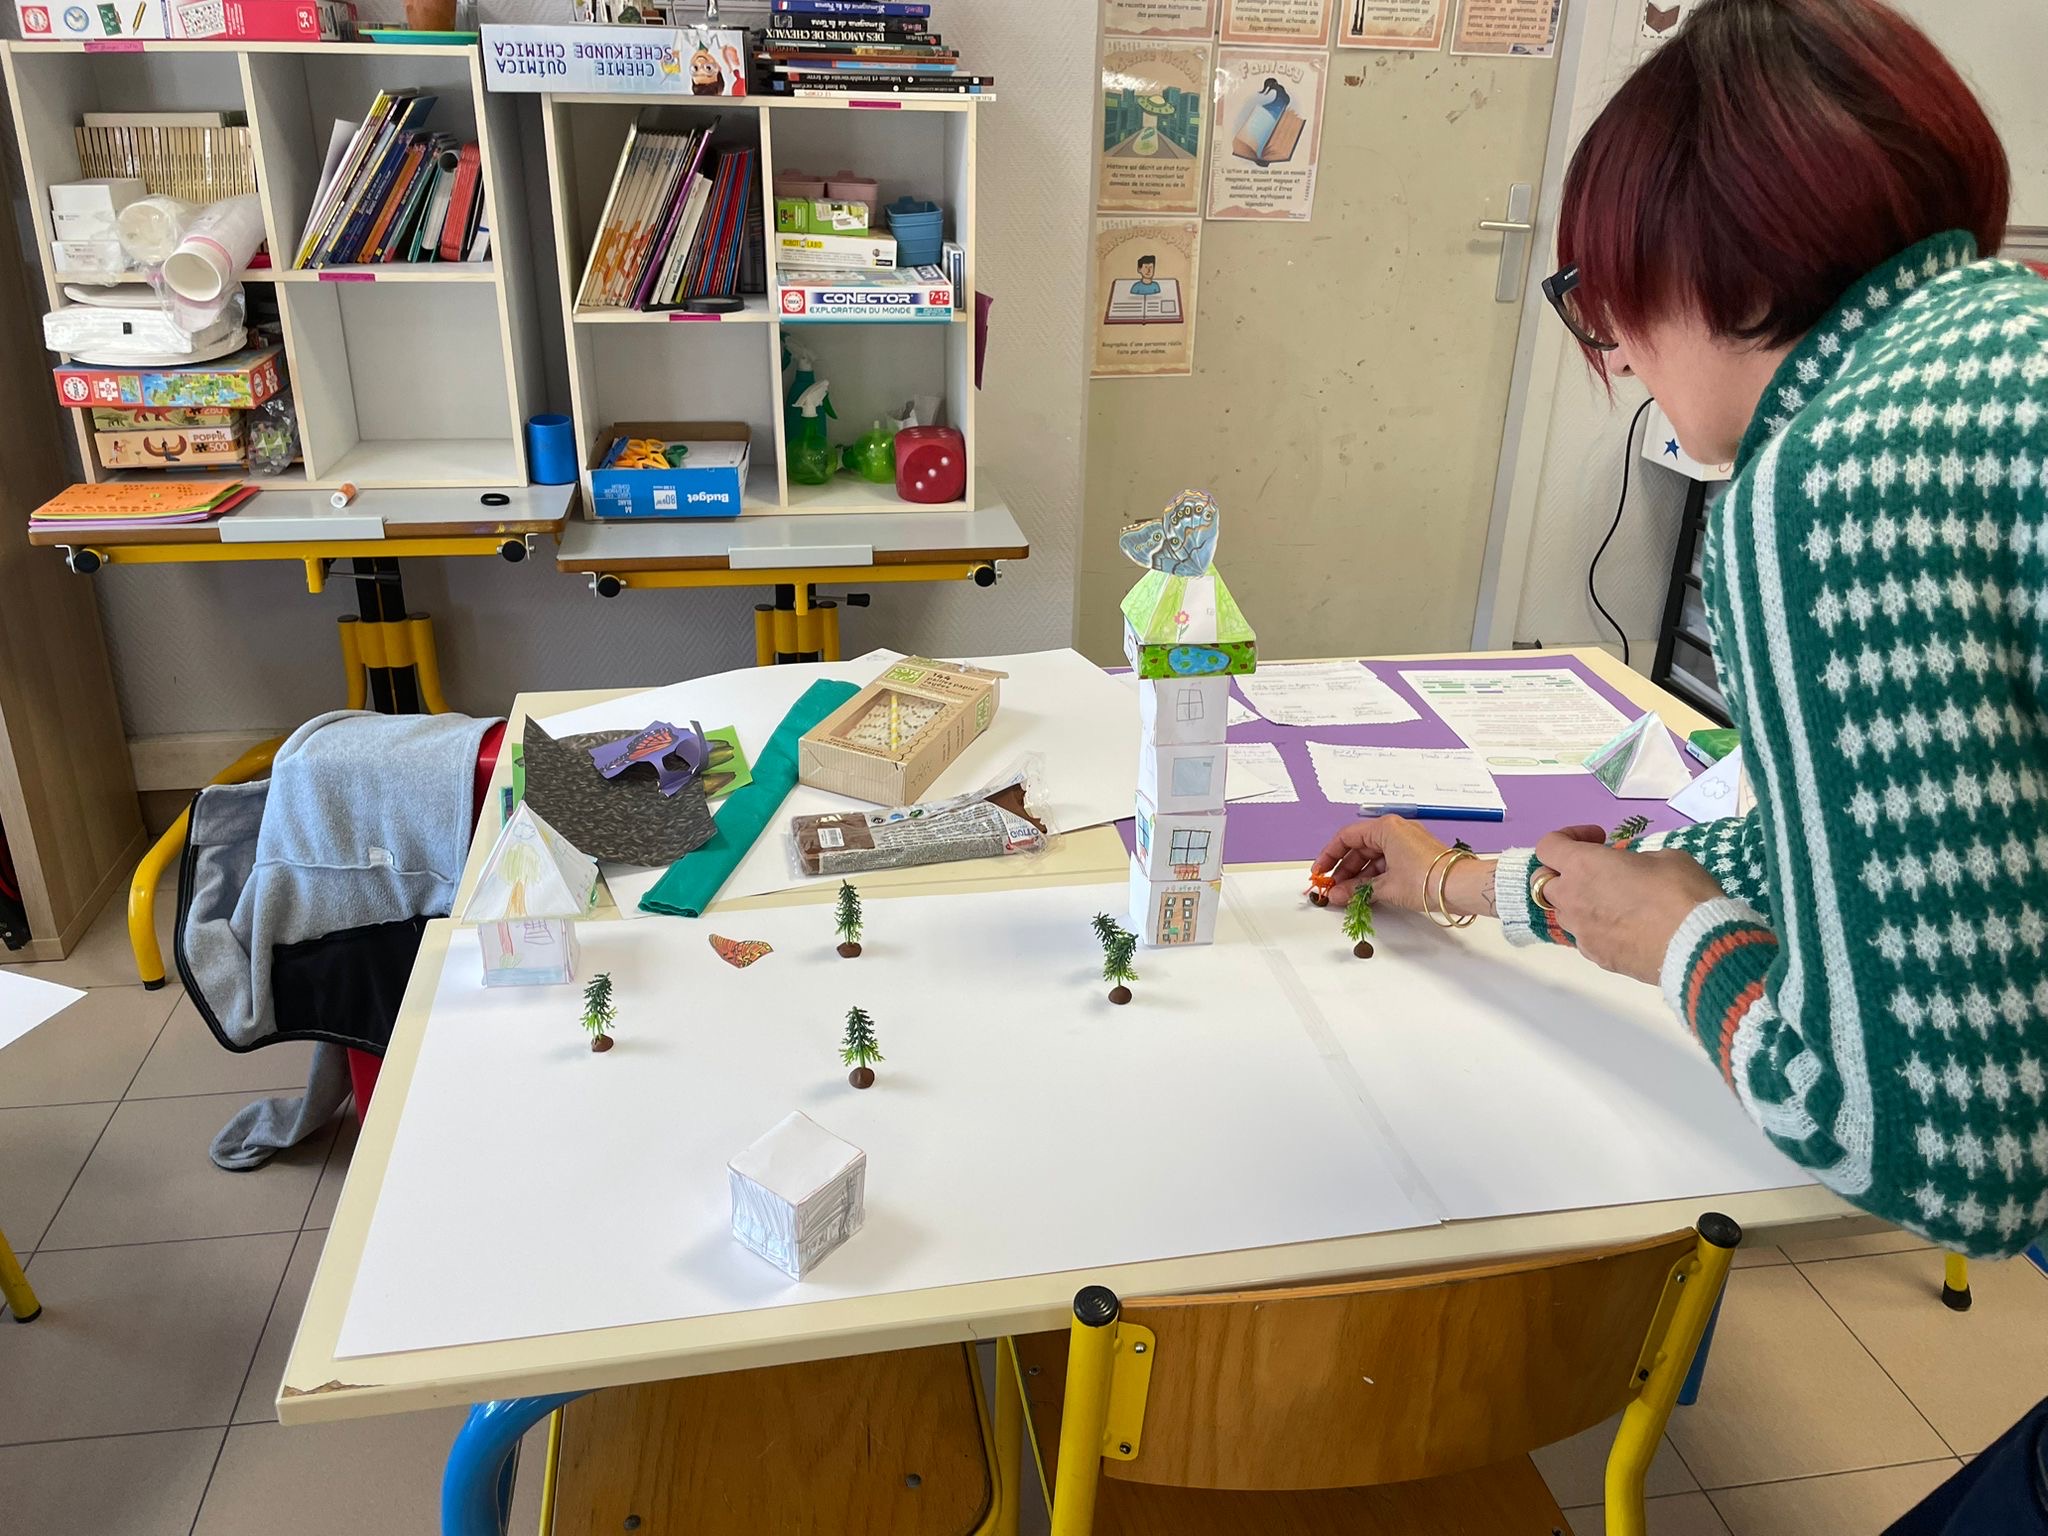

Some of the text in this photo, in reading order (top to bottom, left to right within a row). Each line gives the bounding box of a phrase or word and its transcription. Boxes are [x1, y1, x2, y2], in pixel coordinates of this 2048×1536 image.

[766, 28, 885, 42] DES AMOURS DE CHEVAUX
[495, 43, 673, 61] SCHEIKUNDE CHIMICA
[497, 59, 655, 78] CHEMIE QUÍMICA
[823, 291, 912, 305] CONECTOR
[809, 306, 867, 314] EXPLORATION
[869, 306, 879, 314] DU
[883, 306, 911, 315] MONDE
[208, 442, 229, 451] 500
[687, 490, 729, 503] Budget
